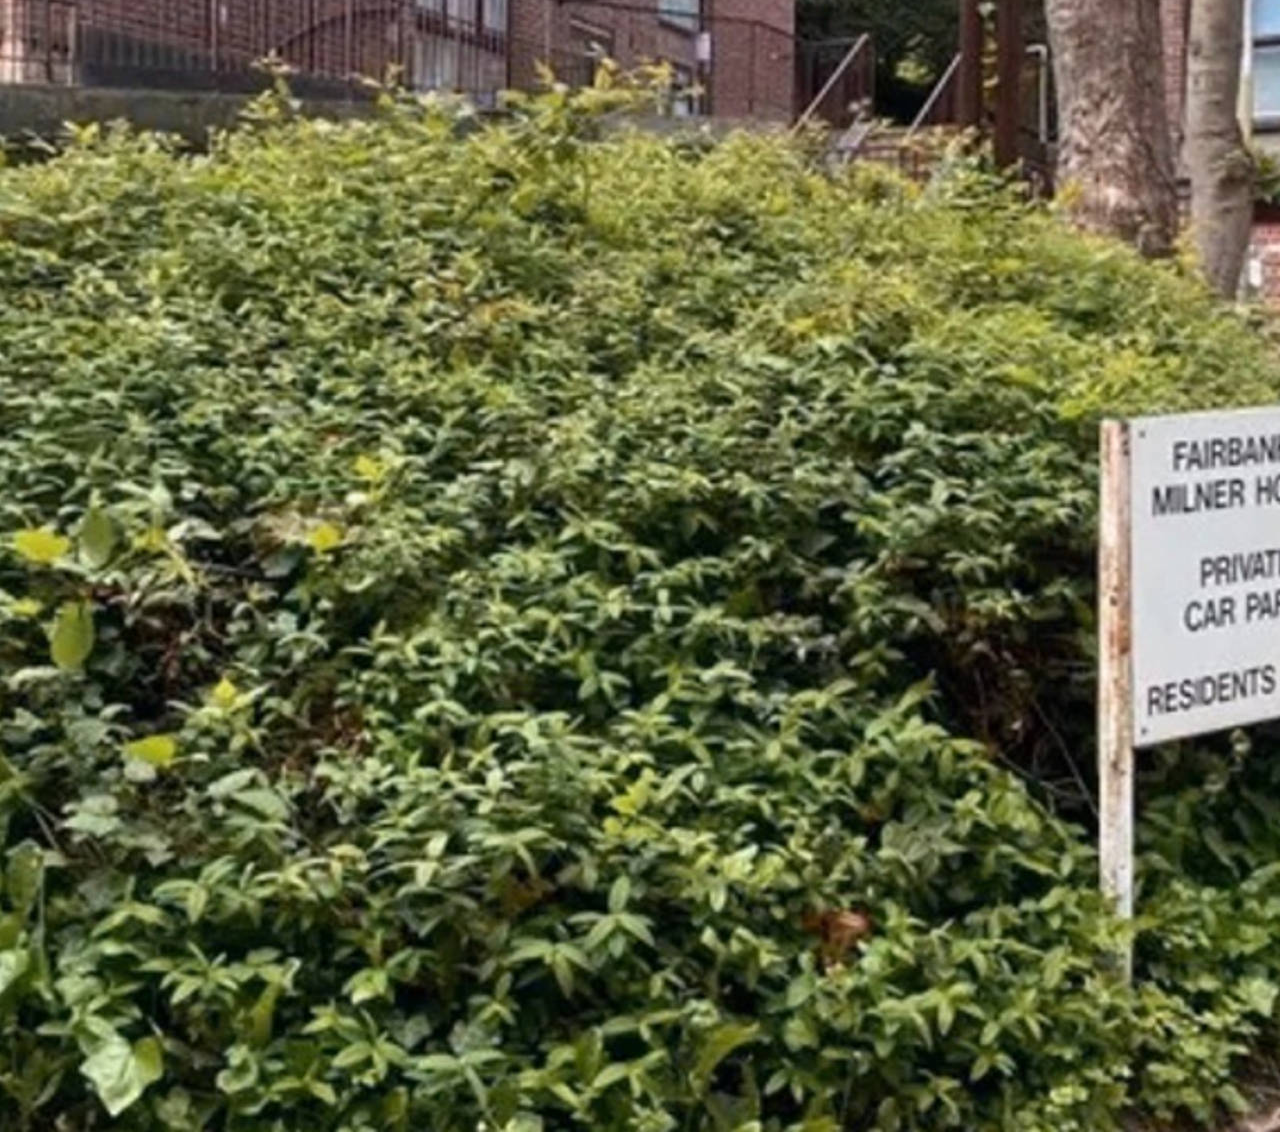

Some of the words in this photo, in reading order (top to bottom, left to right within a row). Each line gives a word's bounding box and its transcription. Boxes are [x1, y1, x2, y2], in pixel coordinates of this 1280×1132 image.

[1152, 479, 1245, 516] MILNER
[1184, 597, 1235, 632] CAR
[1147, 665, 1276, 716] RESIDENTS
